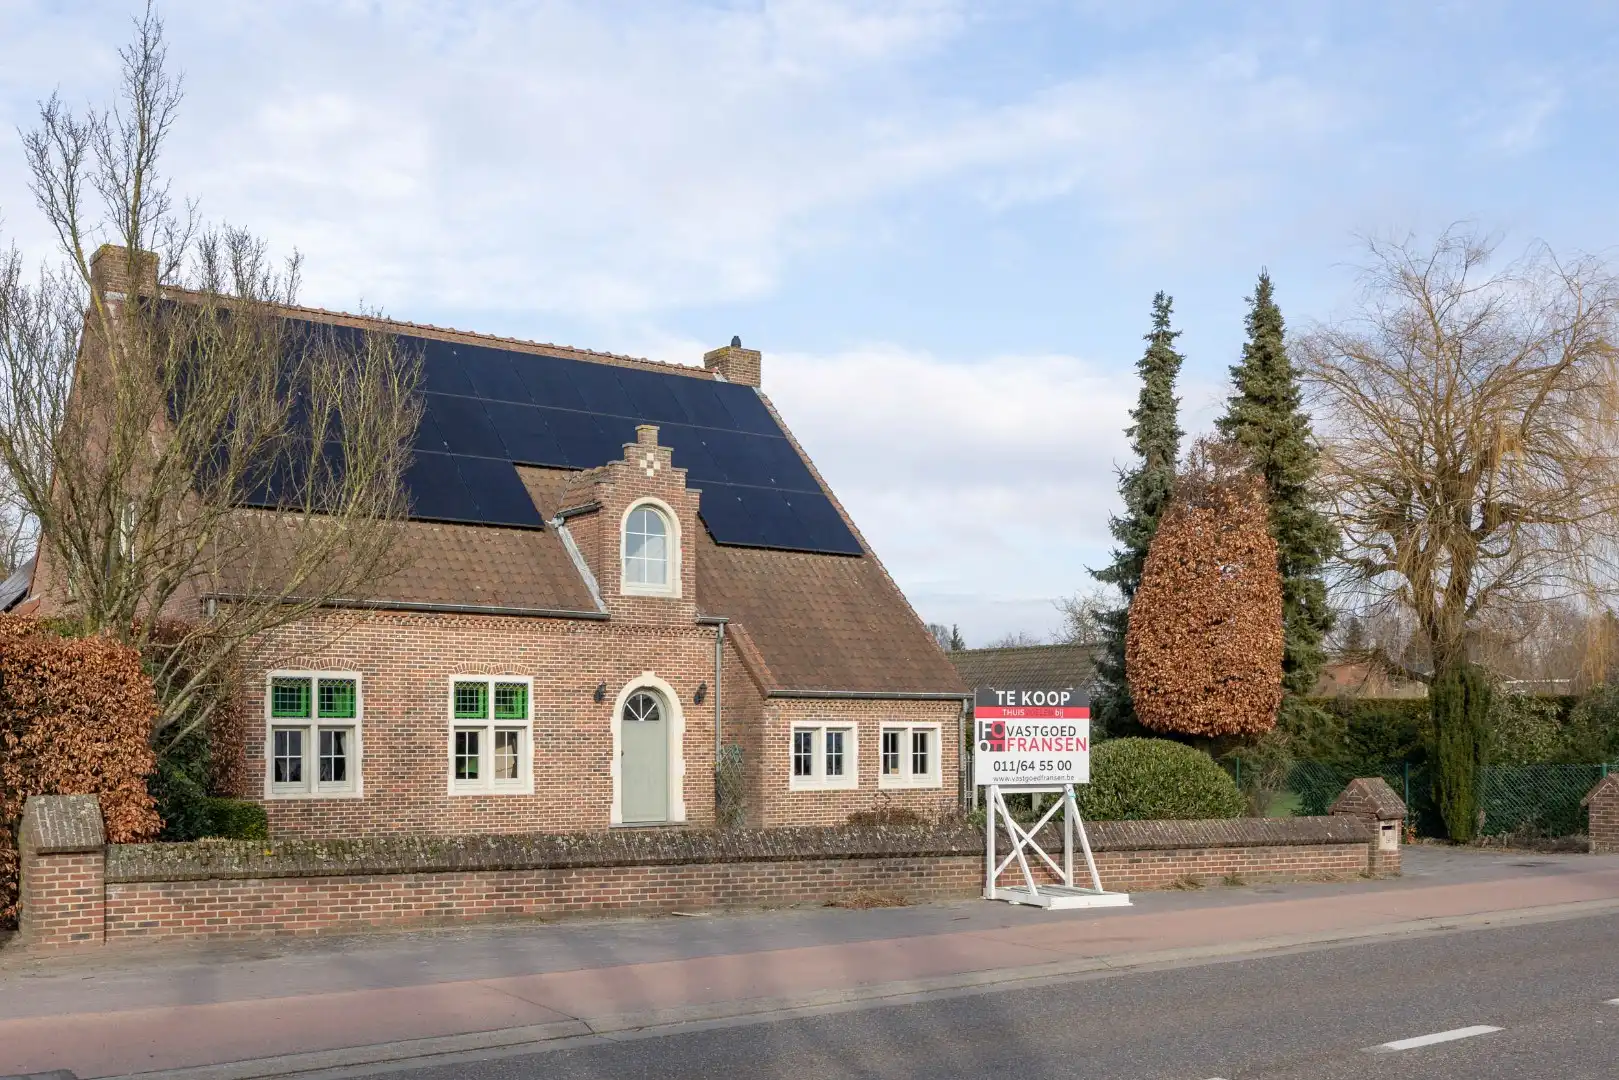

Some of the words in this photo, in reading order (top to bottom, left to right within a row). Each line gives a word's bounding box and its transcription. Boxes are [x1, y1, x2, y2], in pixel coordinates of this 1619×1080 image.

[996, 691, 1016, 706] TE
[1022, 691, 1071, 706] KOOP
[1055, 709, 1064, 718] bij
[1006, 726, 1077, 737] VASTGOED
[1007, 738, 1086, 751] FRANSEN
[993, 760, 1035, 774] 011/64
[1039, 761, 1054, 771] 55
[1057, 760, 1072, 771] 00
[993, 774, 1075, 783] www.vastgoedfransen.be
